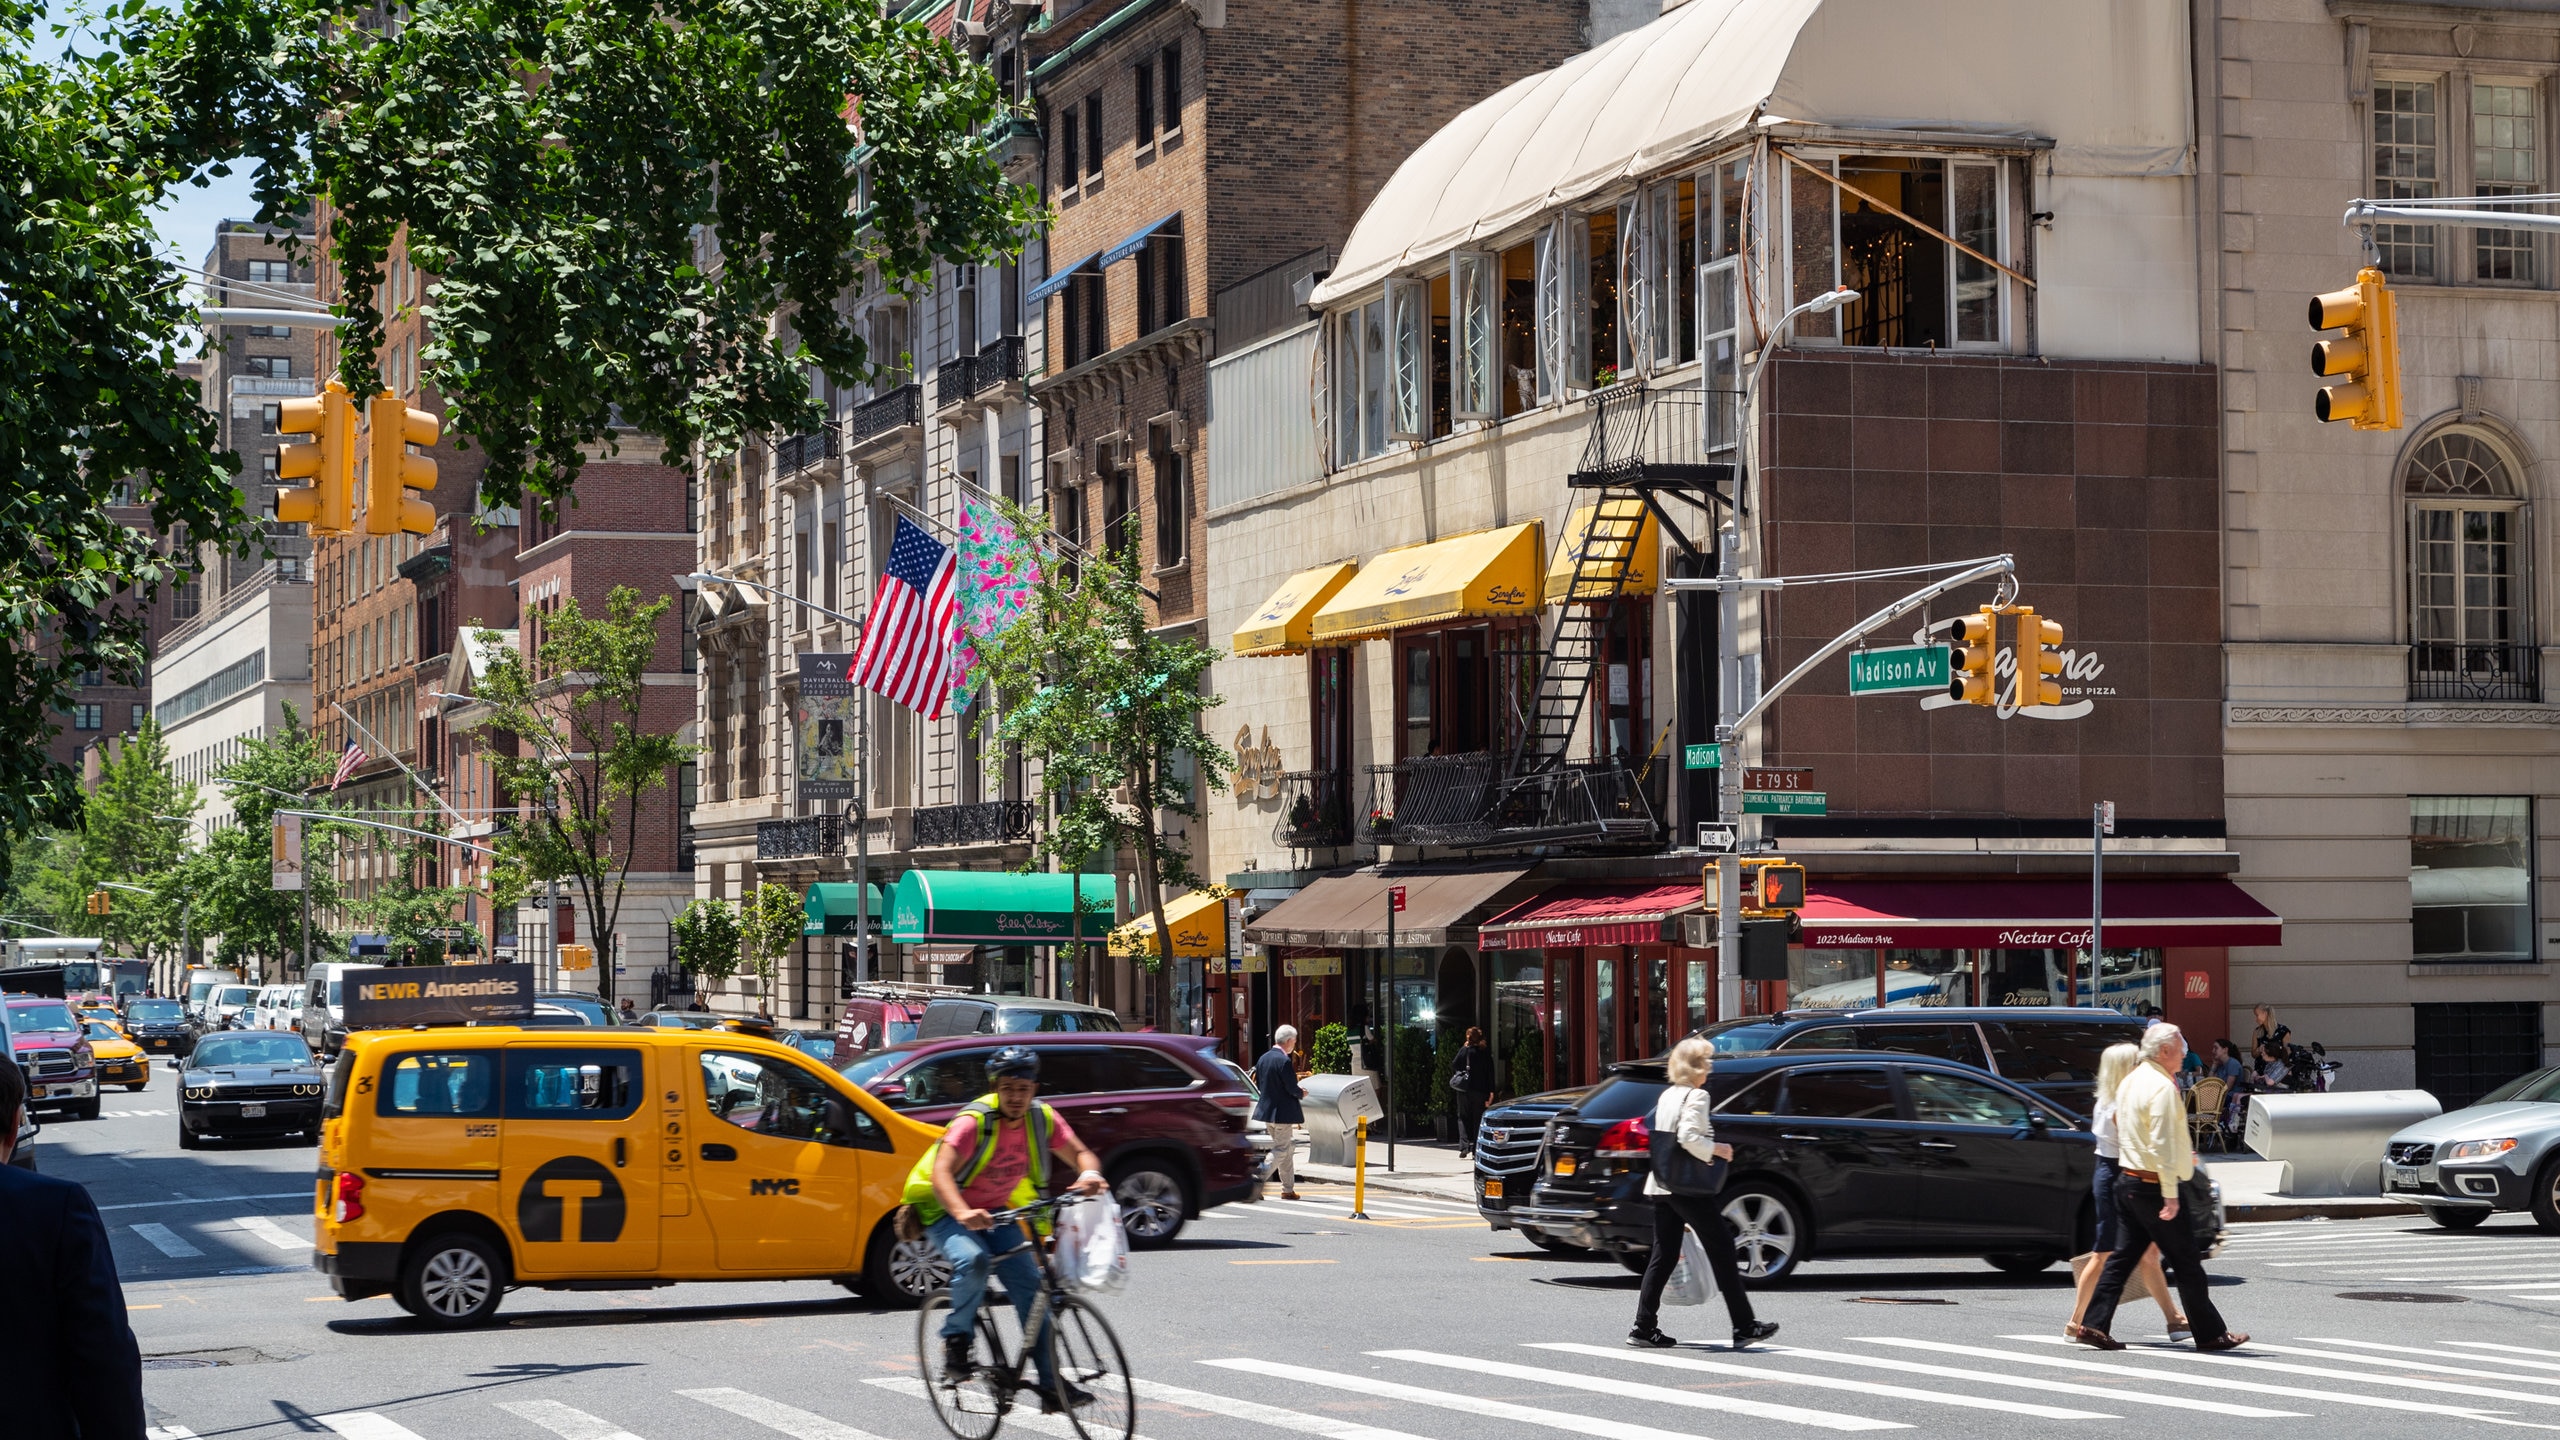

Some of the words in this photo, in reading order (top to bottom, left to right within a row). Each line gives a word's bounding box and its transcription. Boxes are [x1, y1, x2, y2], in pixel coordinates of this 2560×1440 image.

[1100, 249, 1128, 267] SIGNATURE
[1129, 239, 1144, 253] BANK
[1027, 286, 1053, 302] SIGNATURE
[1053, 278, 1067, 290] BANK
[1487, 585, 1526, 602] Serafina
[1856, 660, 1912, 683] Madison
[1916, 657, 1937, 678] Av
[2086, 687, 2117, 695] PIZZA
[1686, 747, 1715, 766] Madison
[1756, 773, 1762, 788] E
[1767, 773, 1781, 788] 79
[1786, 773, 1799, 789] St
[1744, 793, 1769, 804] ECUMENICAL
[1770, 794, 1794, 804] PATRIARCH
[1795, 795, 1826, 805] BARTHOLOMEW
[1779, 804, 1791, 812] WAY
[1703, 832, 1715, 844] ONE
[1720, 833, 1732, 845] WAY
[996, 914, 1026, 934] Lilly
[1025, 914, 1061, 933] Pulitzer
[1176, 930, 1209, 946] Serafina
[1261, 930, 1285, 943] MICHAEL
[1406, 933, 1432, 944] ASHTON
[1546, 930, 1567, 944] Nectar
[1566, 928, 1581, 946] Cafe
[1816, 935, 1837, 944] 1022
[1838, 934, 1874, 944] Madison
[1875, 934, 1894, 944] Ave.
[1999, 931, 2055, 945] Nectar
[2058, 930, 2094, 947] Cafe
[919, 953, 925, 961] LA
[359, 982, 421, 1001] NEWR
[424, 978, 519, 998] Amenities
[2186, 975, 2208, 996] illy
[1910, 993, 1949, 1007] Lunch
[2003, 992, 2049, 1006] Dinner
[750, 1178, 800, 1196] NYC
